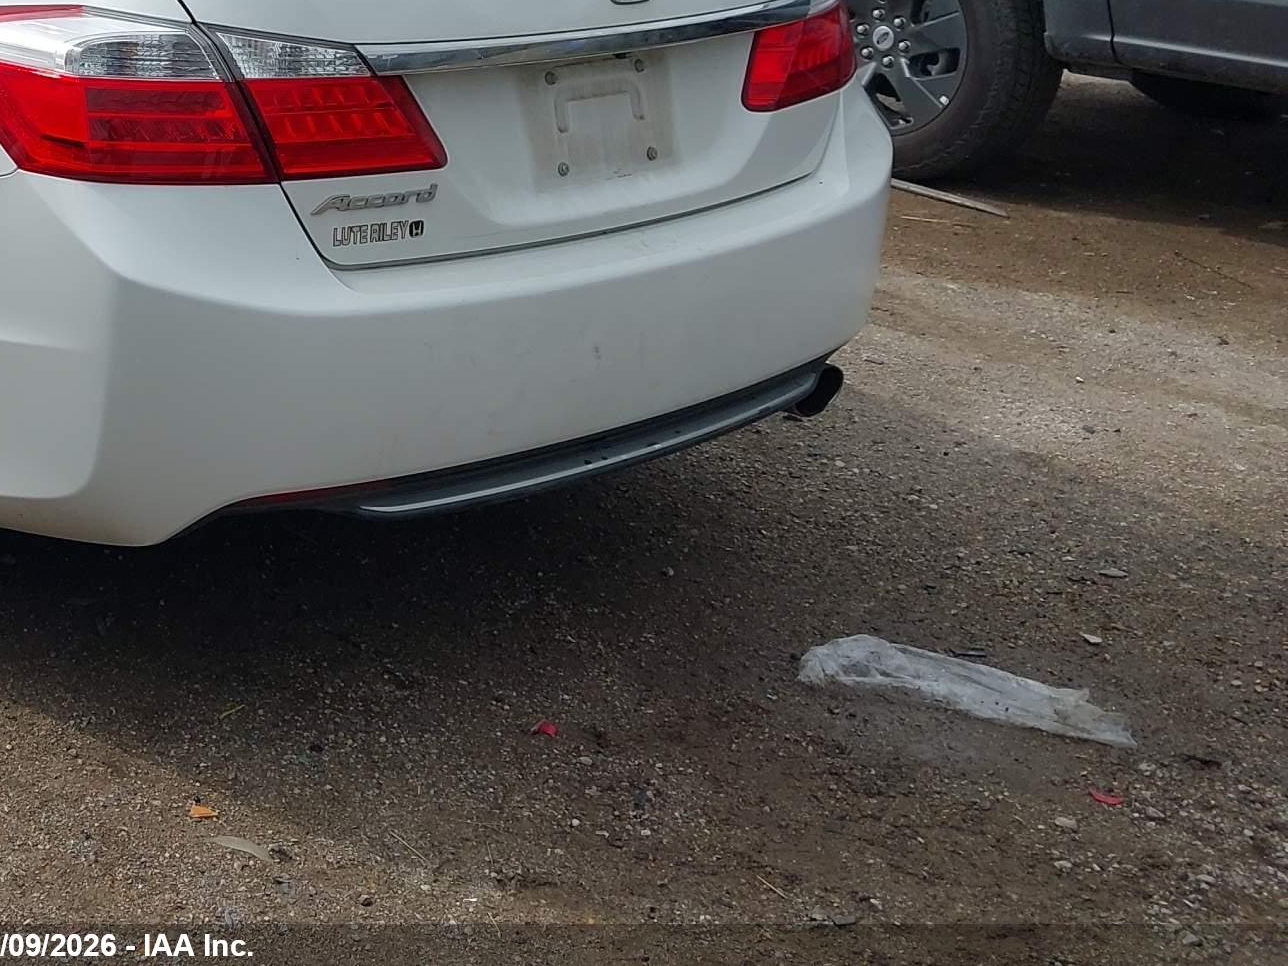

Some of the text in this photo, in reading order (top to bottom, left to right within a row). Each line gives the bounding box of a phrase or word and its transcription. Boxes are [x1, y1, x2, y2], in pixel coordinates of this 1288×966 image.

[310, 183, 439, 215] Accord
[332, 224, 369, 247] LUTE
[369, 220, 410, 243] RILEY
